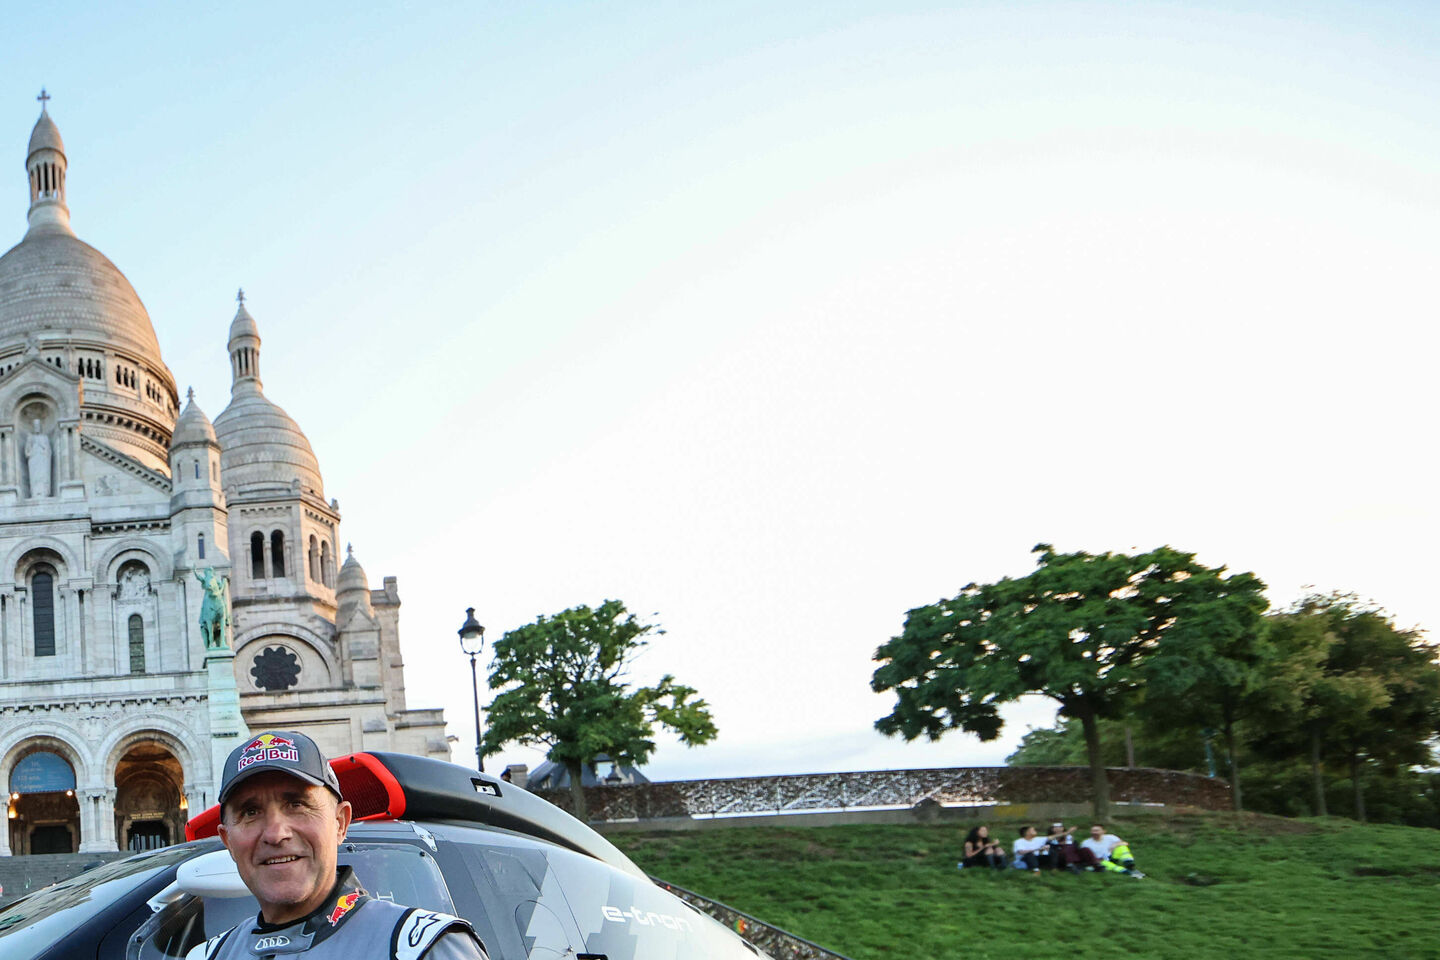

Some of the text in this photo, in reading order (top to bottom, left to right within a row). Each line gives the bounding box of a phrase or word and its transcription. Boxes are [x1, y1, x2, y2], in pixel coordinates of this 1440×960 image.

[238, 748, 299, 771] Red Bull
[601, 905, 694, 933] e-tron
